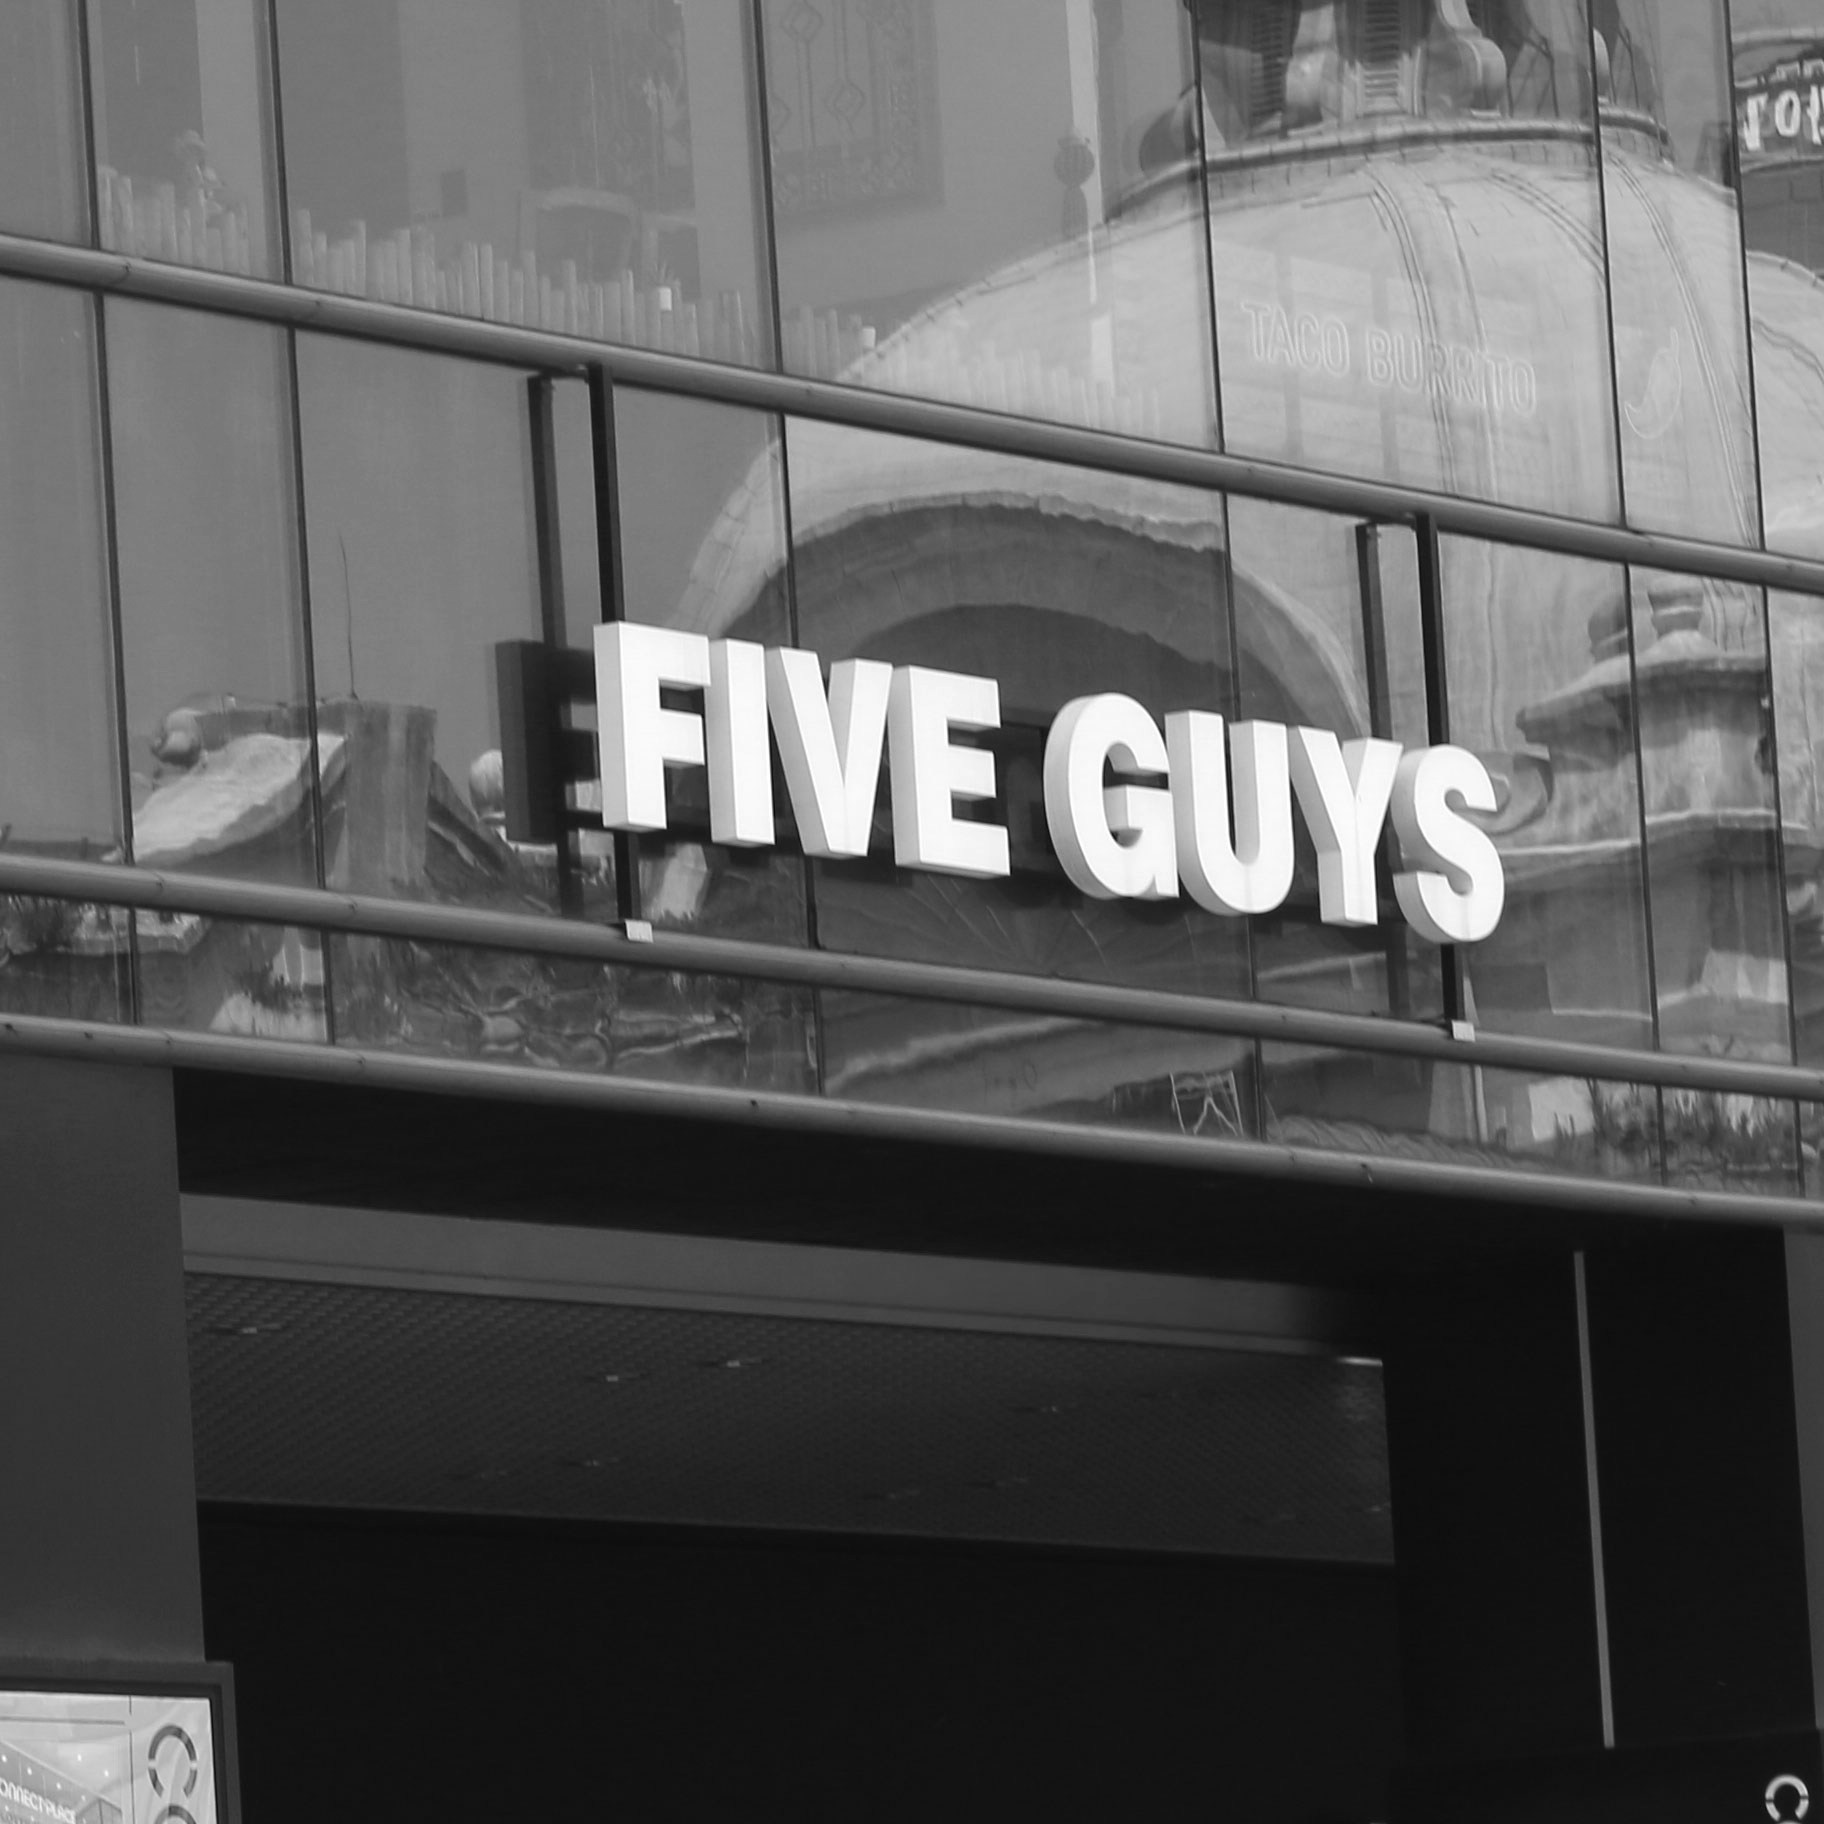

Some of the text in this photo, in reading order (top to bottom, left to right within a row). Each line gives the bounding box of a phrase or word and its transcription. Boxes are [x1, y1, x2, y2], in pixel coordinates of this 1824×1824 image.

[1240, 299, 1350, 379] TACO
[593, 621, 1506, 945] FIVE GUYS
